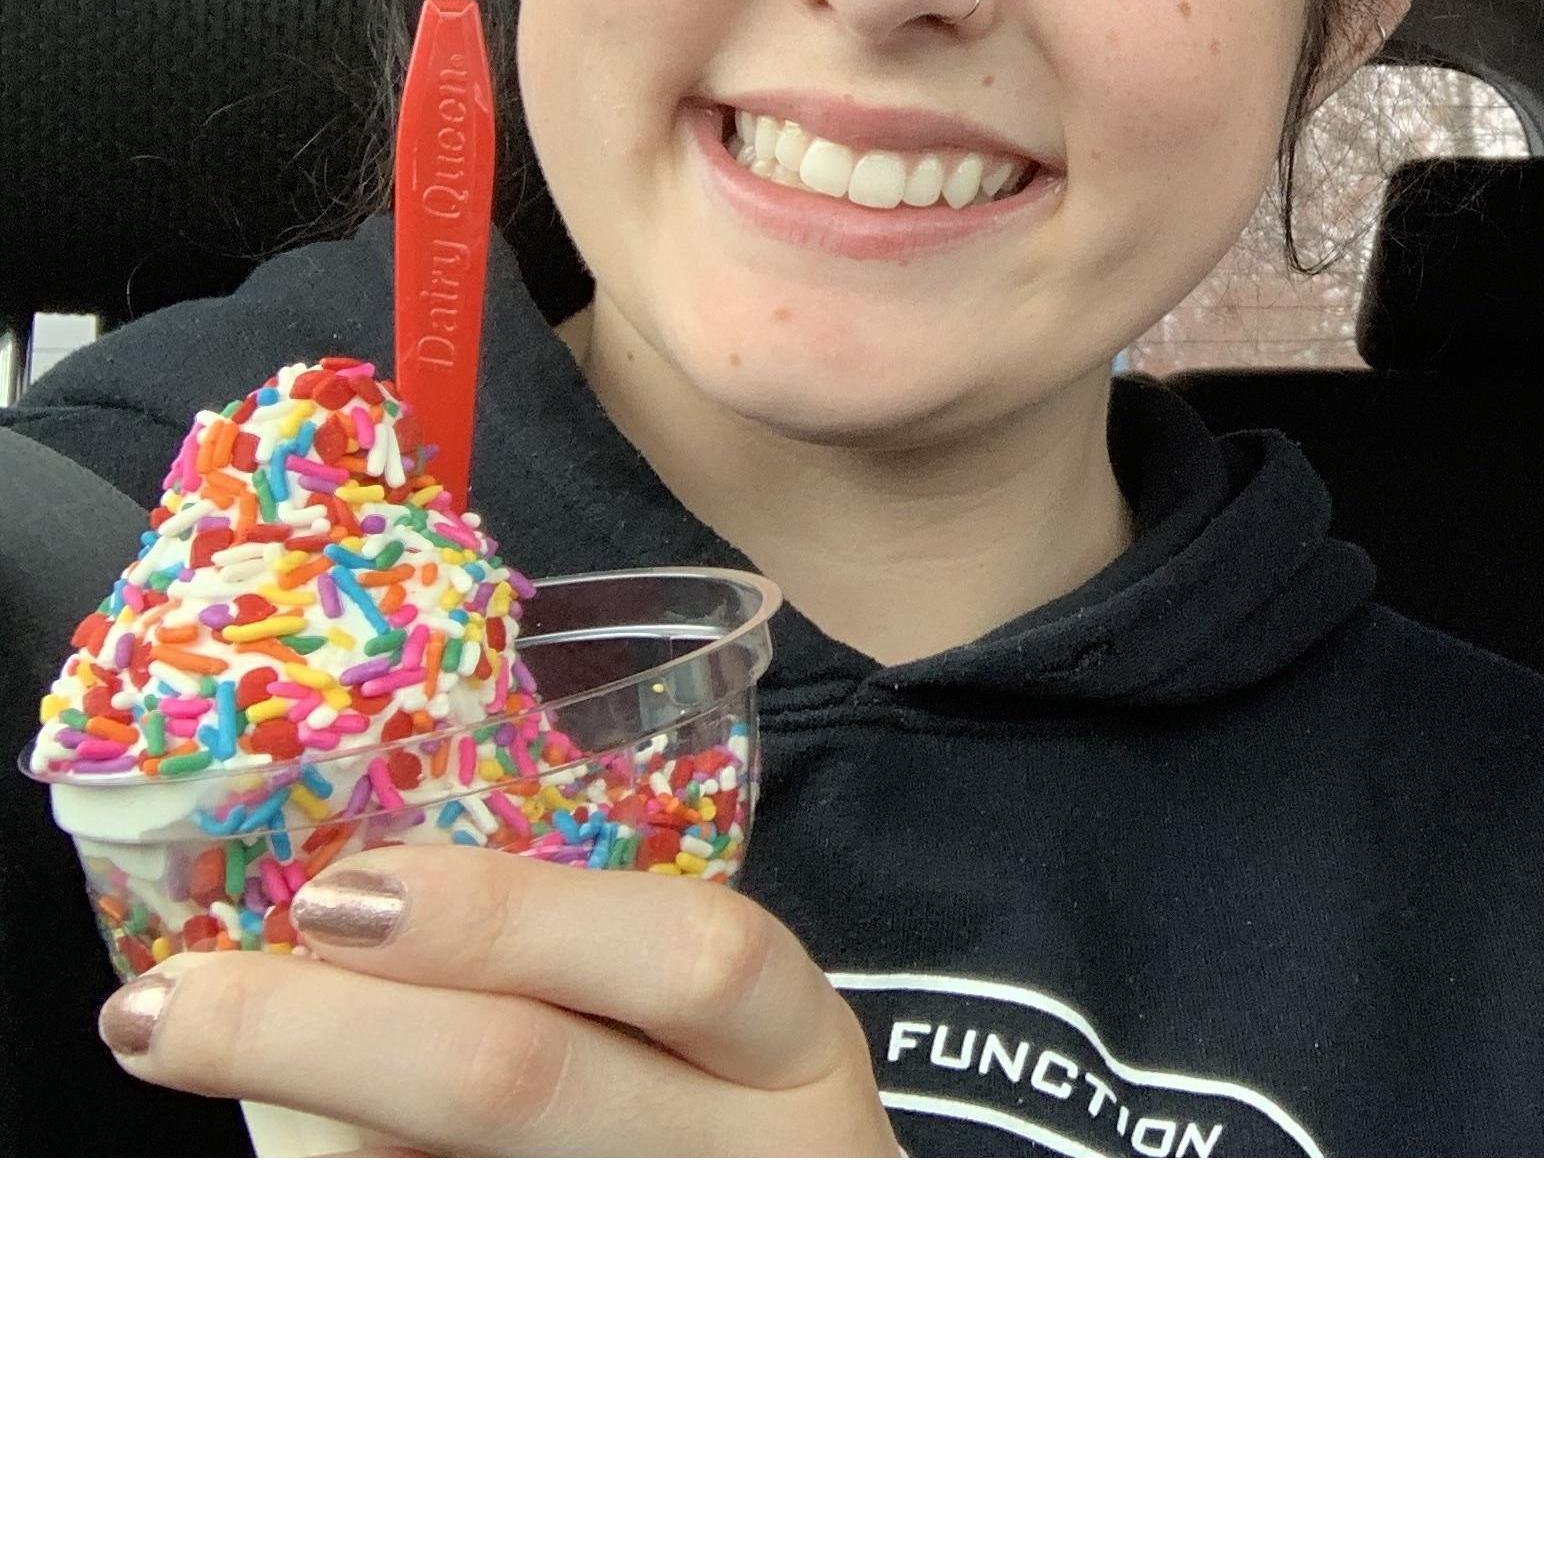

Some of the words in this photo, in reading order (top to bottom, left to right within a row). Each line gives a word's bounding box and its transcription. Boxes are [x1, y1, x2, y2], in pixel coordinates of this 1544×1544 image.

[423, 67, 469, 219] Queen
[418, 239, 472, 368] Dairy
[887, 1021, 1223, 1157] FUNCTION
